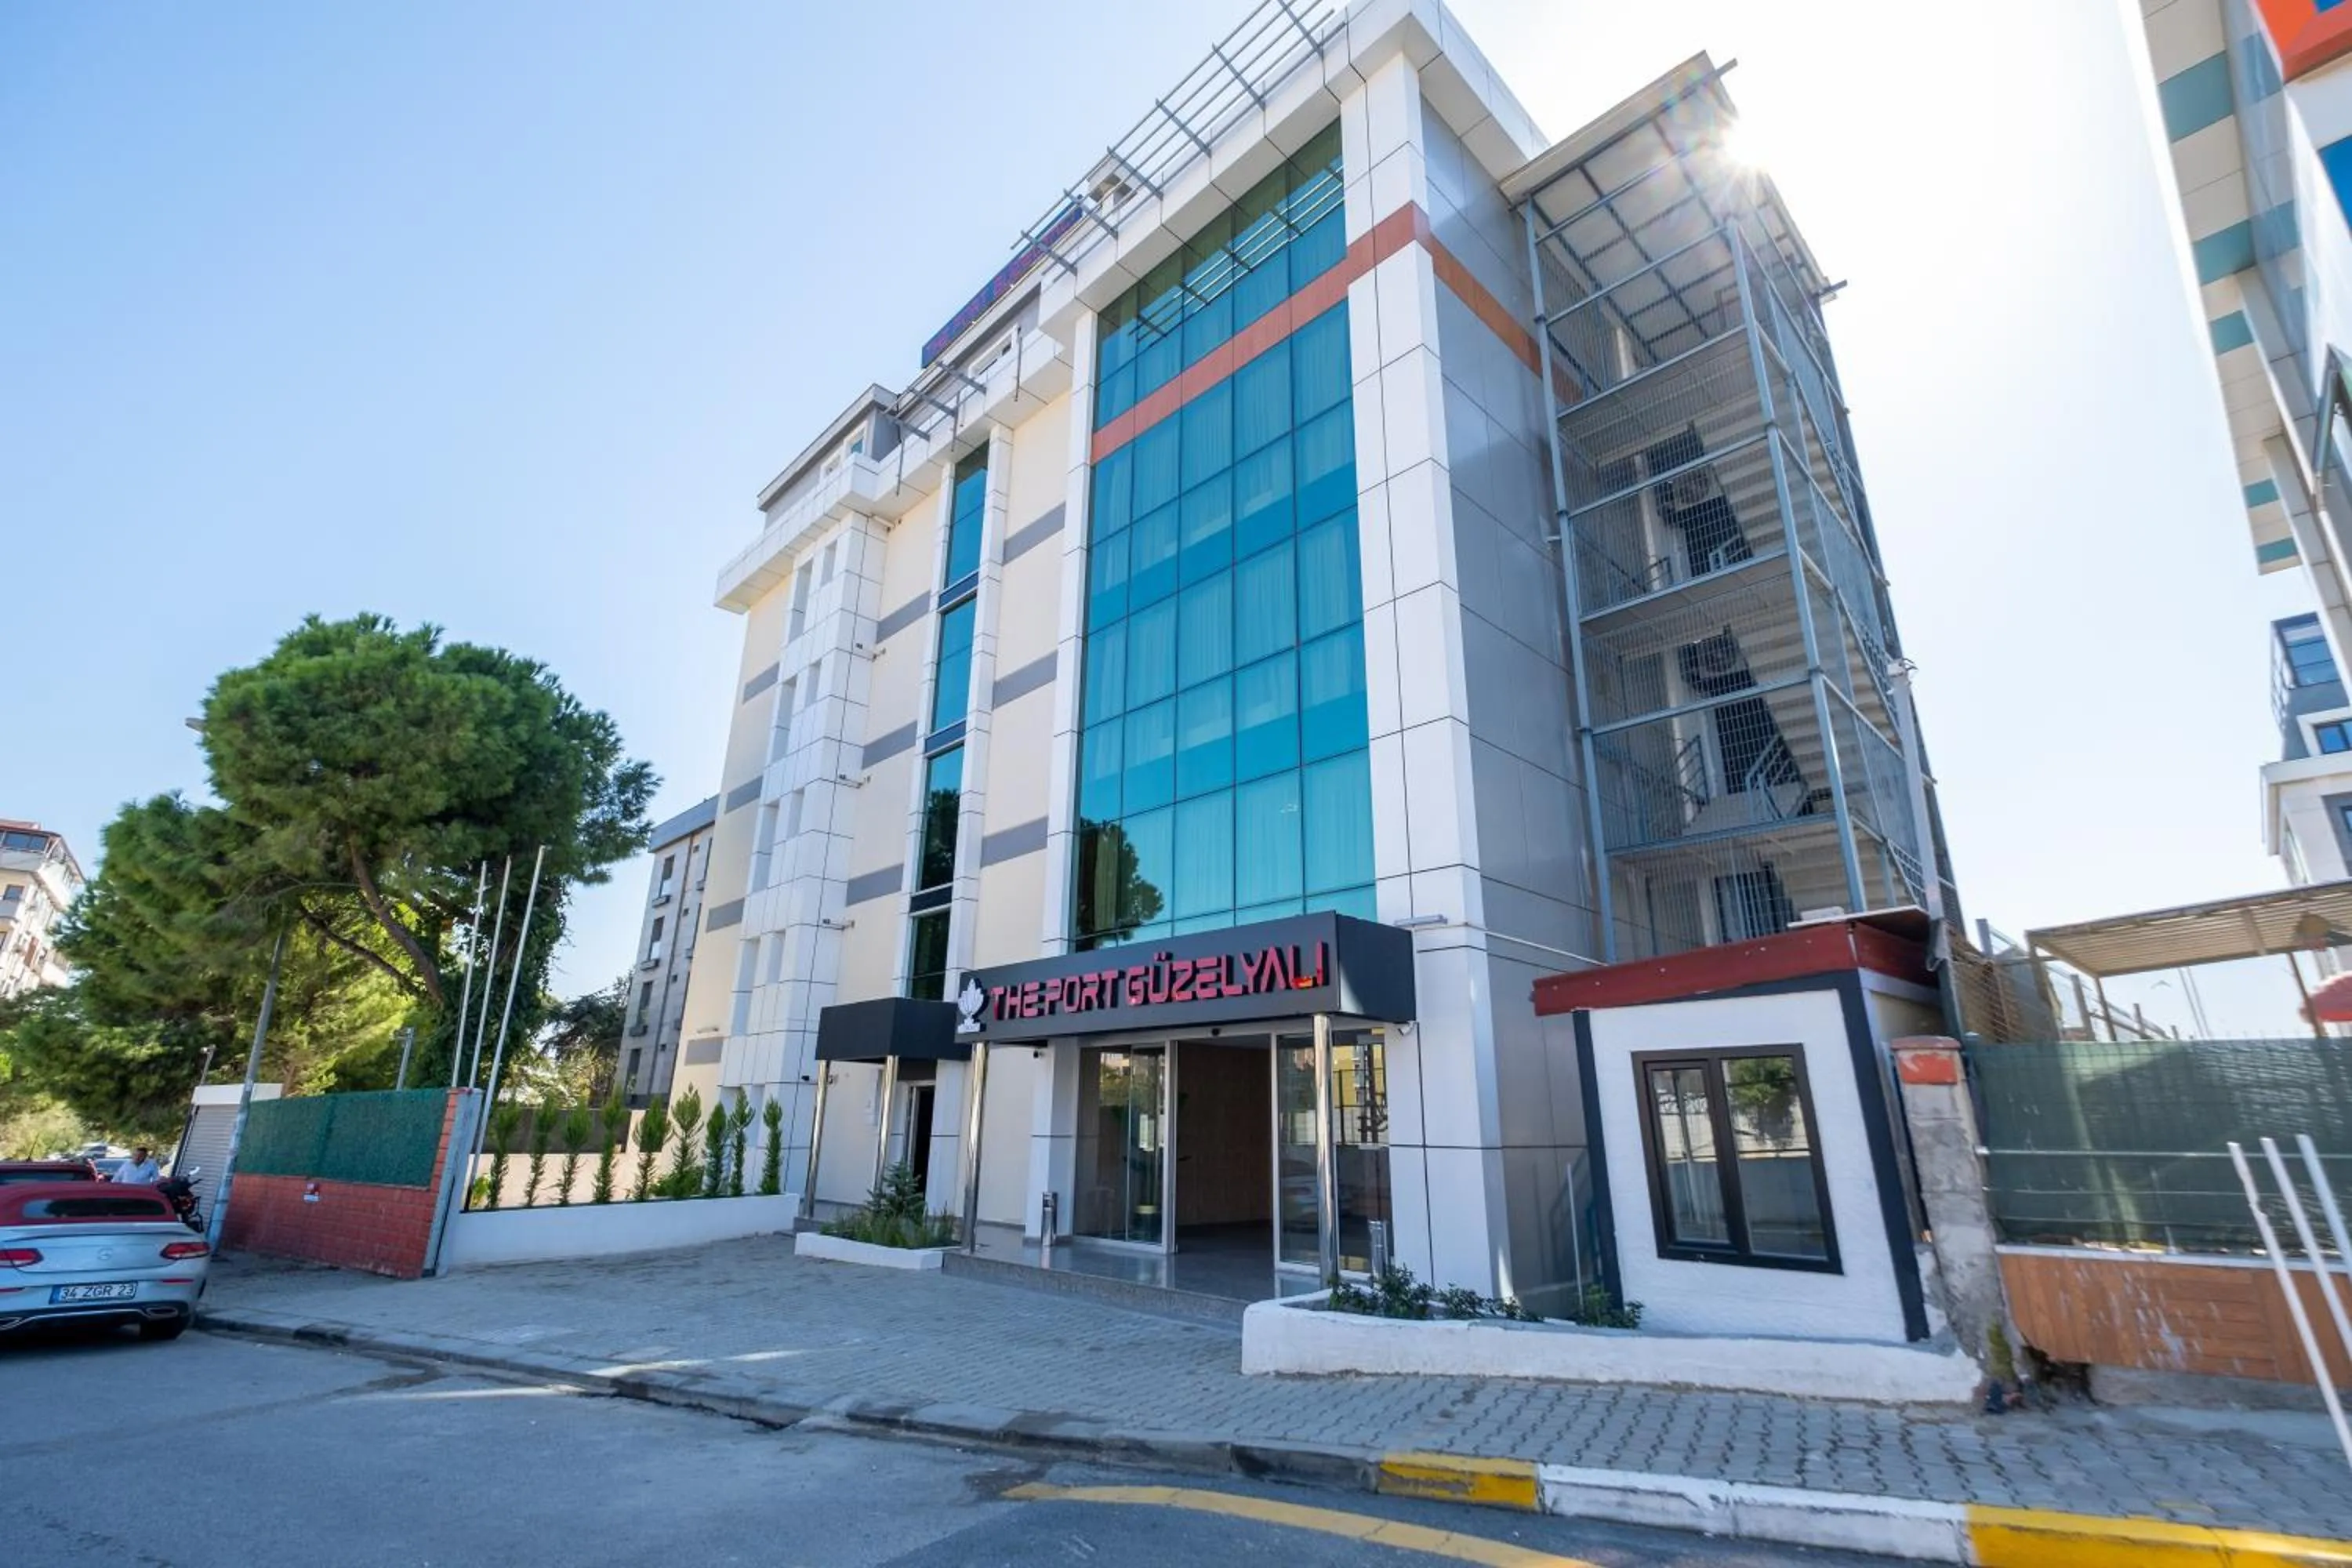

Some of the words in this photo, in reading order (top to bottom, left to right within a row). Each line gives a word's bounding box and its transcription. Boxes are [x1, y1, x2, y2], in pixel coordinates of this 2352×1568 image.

[1045, 969, 1119, 1014] PORT
[1124, 939, 1325, 1006] GÜZELYALI
[61, 1286, 77, 1299] 34
